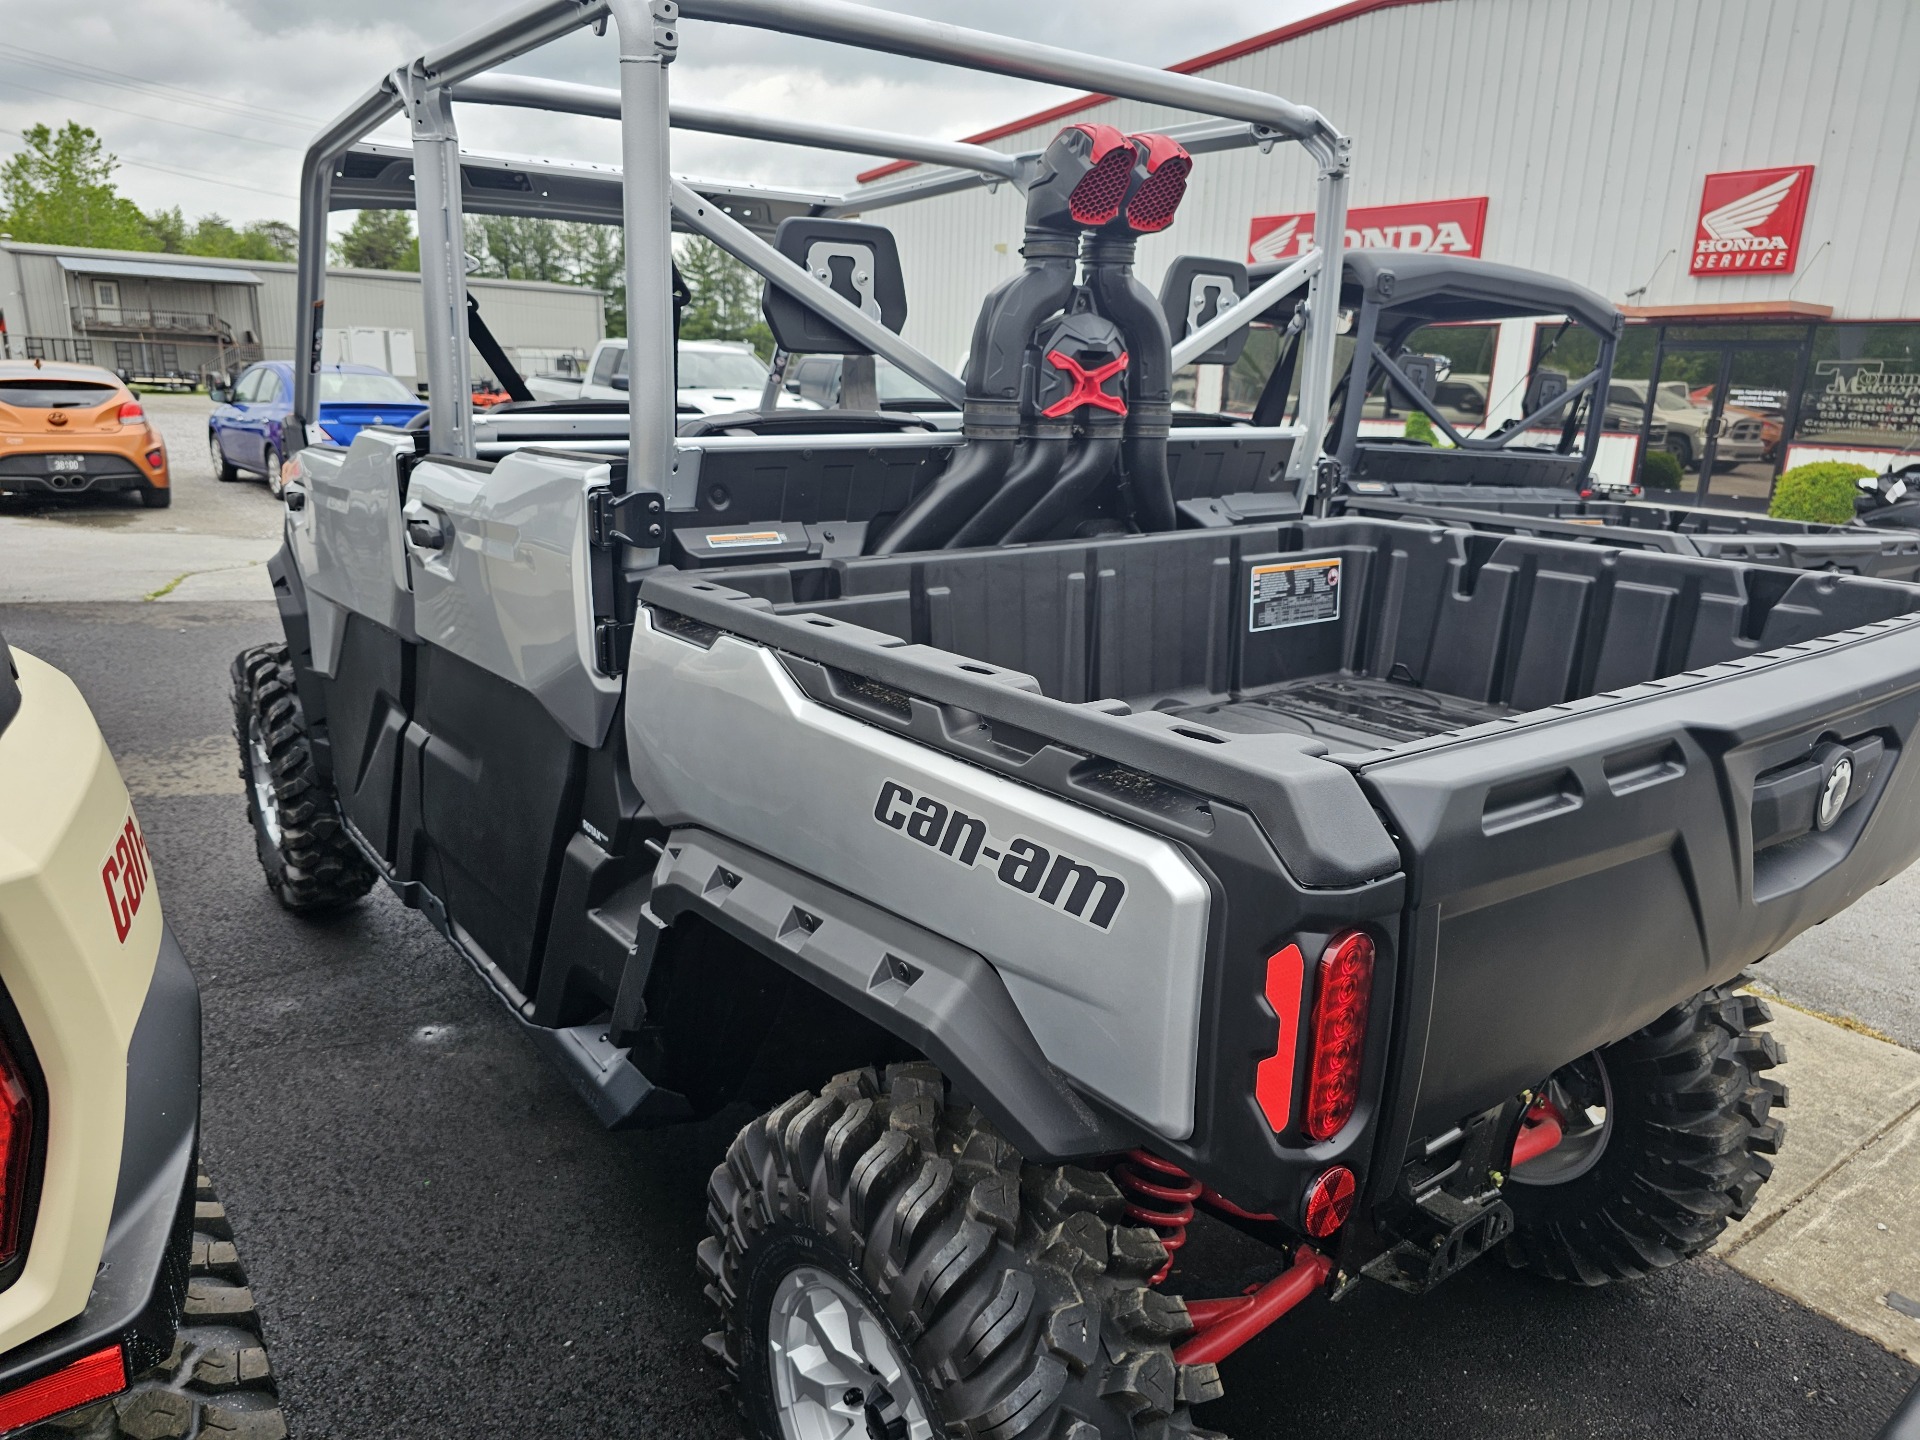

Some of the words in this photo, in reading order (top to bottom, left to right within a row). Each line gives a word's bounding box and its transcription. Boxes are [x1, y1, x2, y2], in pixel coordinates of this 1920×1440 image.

[1693, 251, 1788, 269] SERVICE
[1696, 236, 1789, 253] HONDA
[102, 815, 151, 945] can-
[874, 780, 1126, 930] can-am
